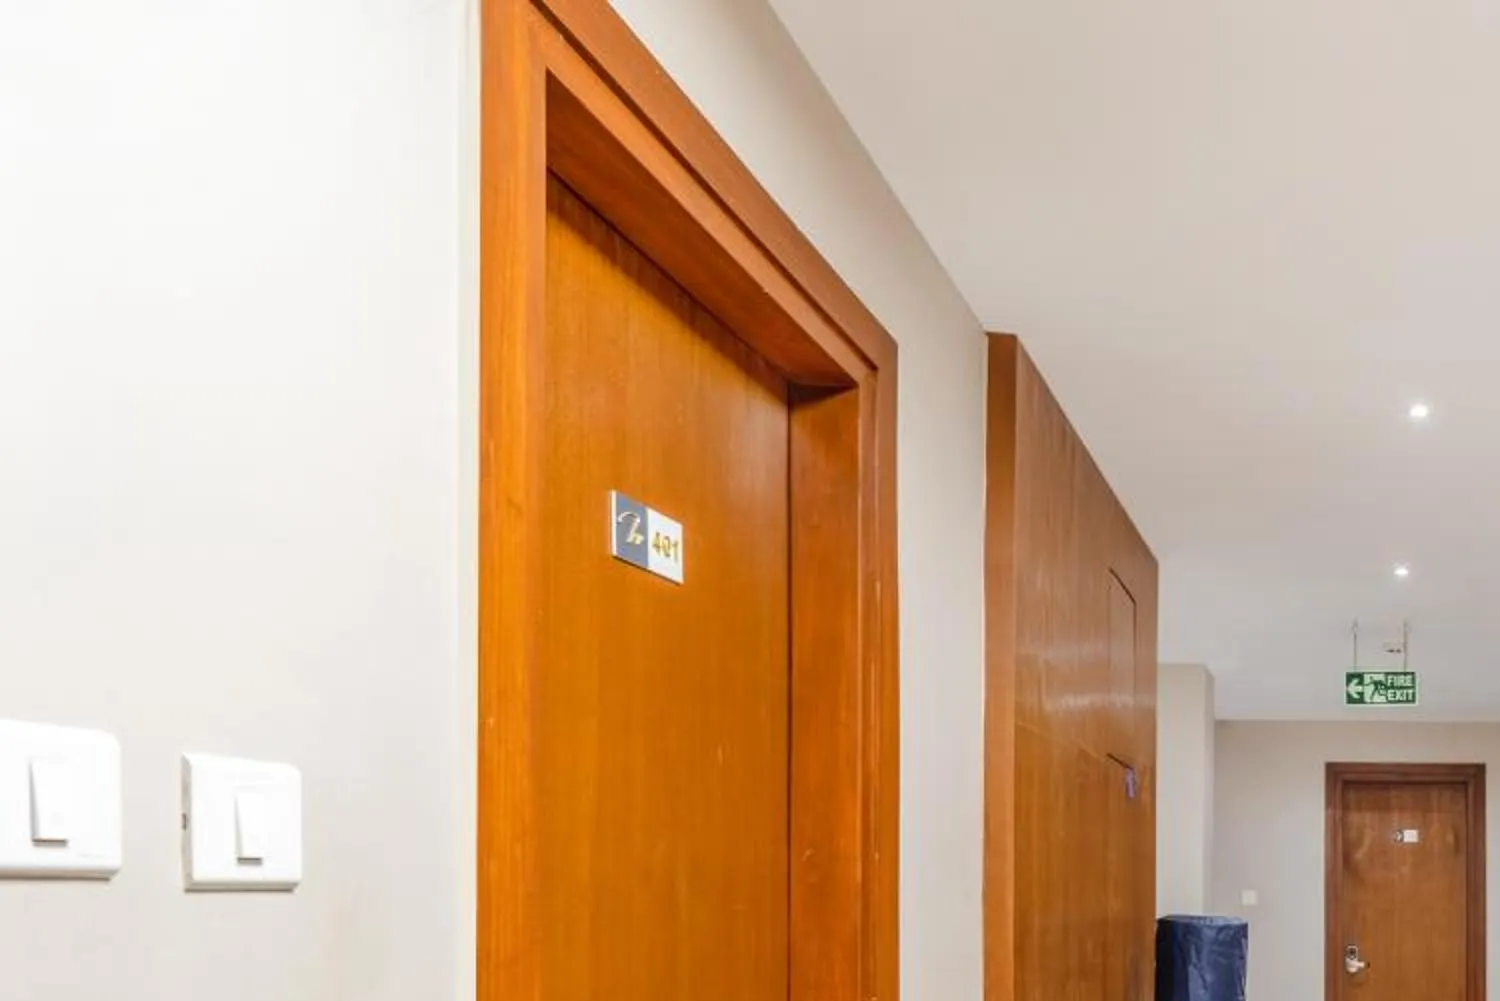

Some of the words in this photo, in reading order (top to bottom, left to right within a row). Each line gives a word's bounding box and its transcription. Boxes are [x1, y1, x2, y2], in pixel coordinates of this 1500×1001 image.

[652, 531, 679, 563] 401
[1387, 675, 1413, 686] FIRE
[1387, 689, 1413, 701] EXIT
